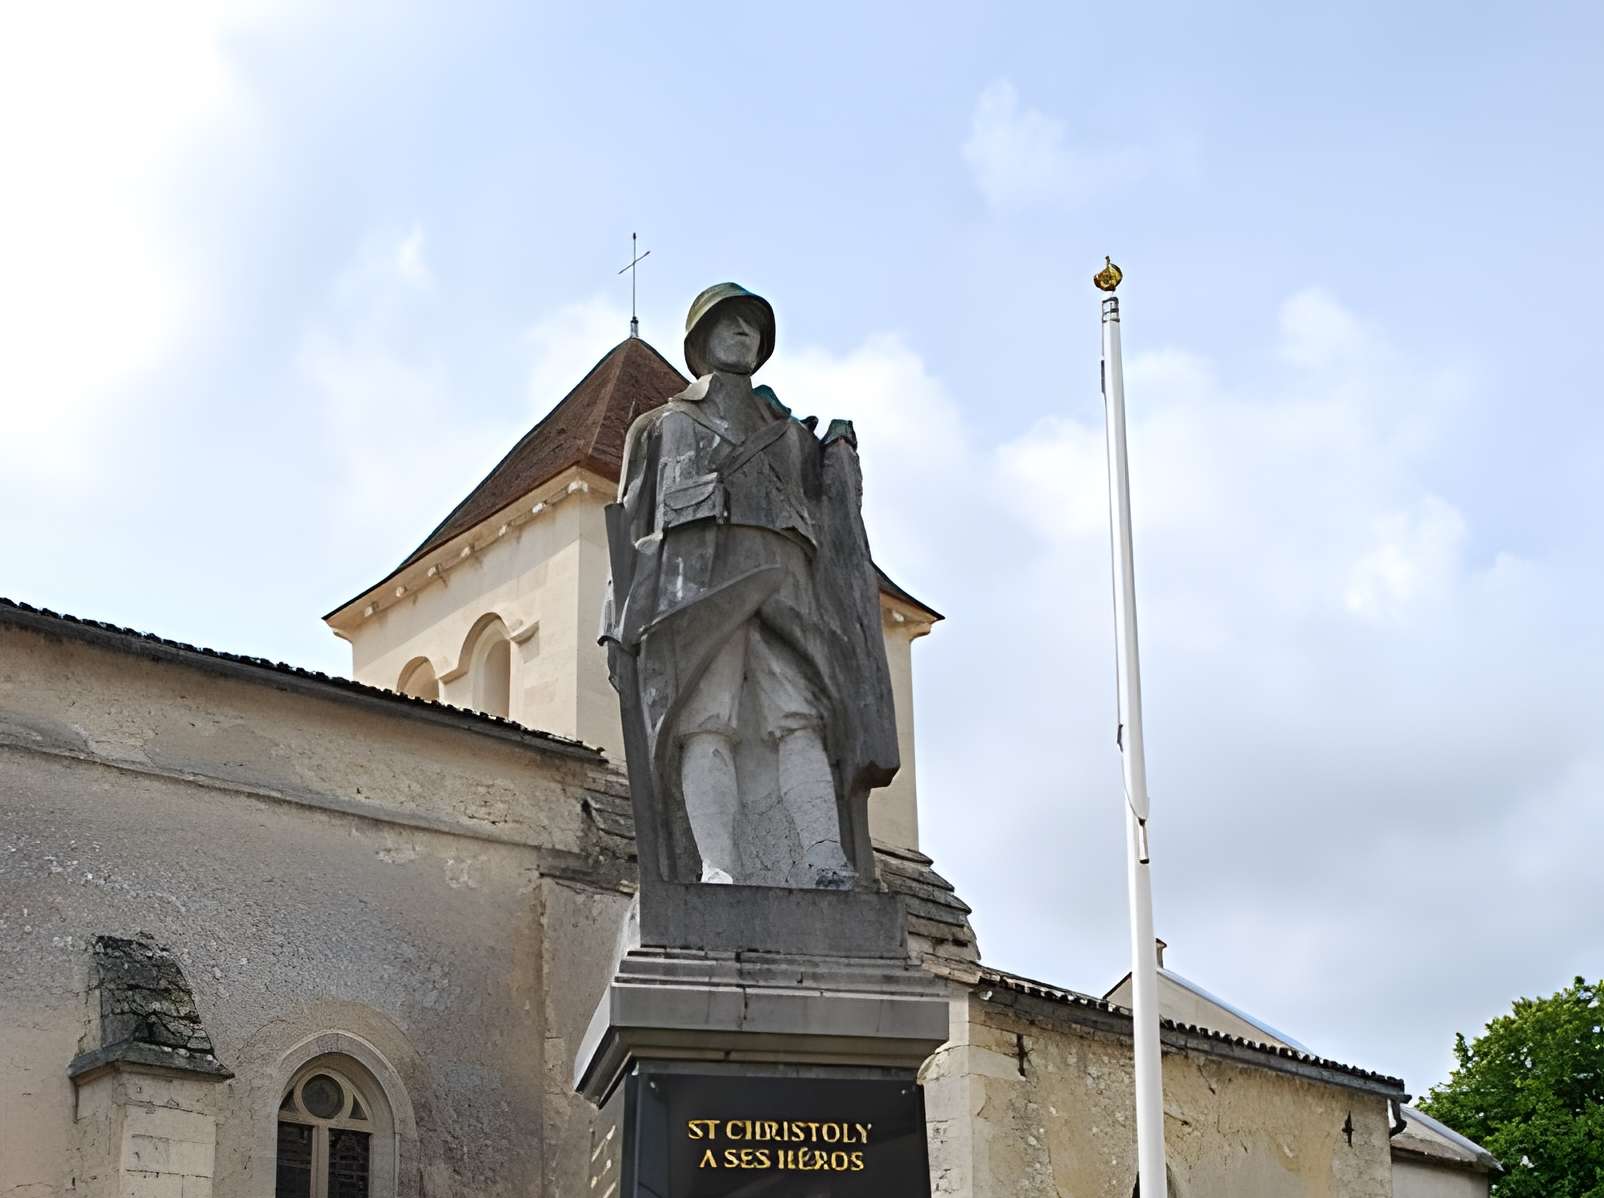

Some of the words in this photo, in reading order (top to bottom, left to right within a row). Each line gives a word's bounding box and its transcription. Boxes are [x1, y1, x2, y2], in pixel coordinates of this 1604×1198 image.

[687, 1119, 720, 1140] ST
[725, 1119, 872, 1144] CHRISTOLY
[699, 1149, 718, 1169] A
[723, 1149, 771, 1169] SES
[778, 1147, 865, 1171] HÉROS
